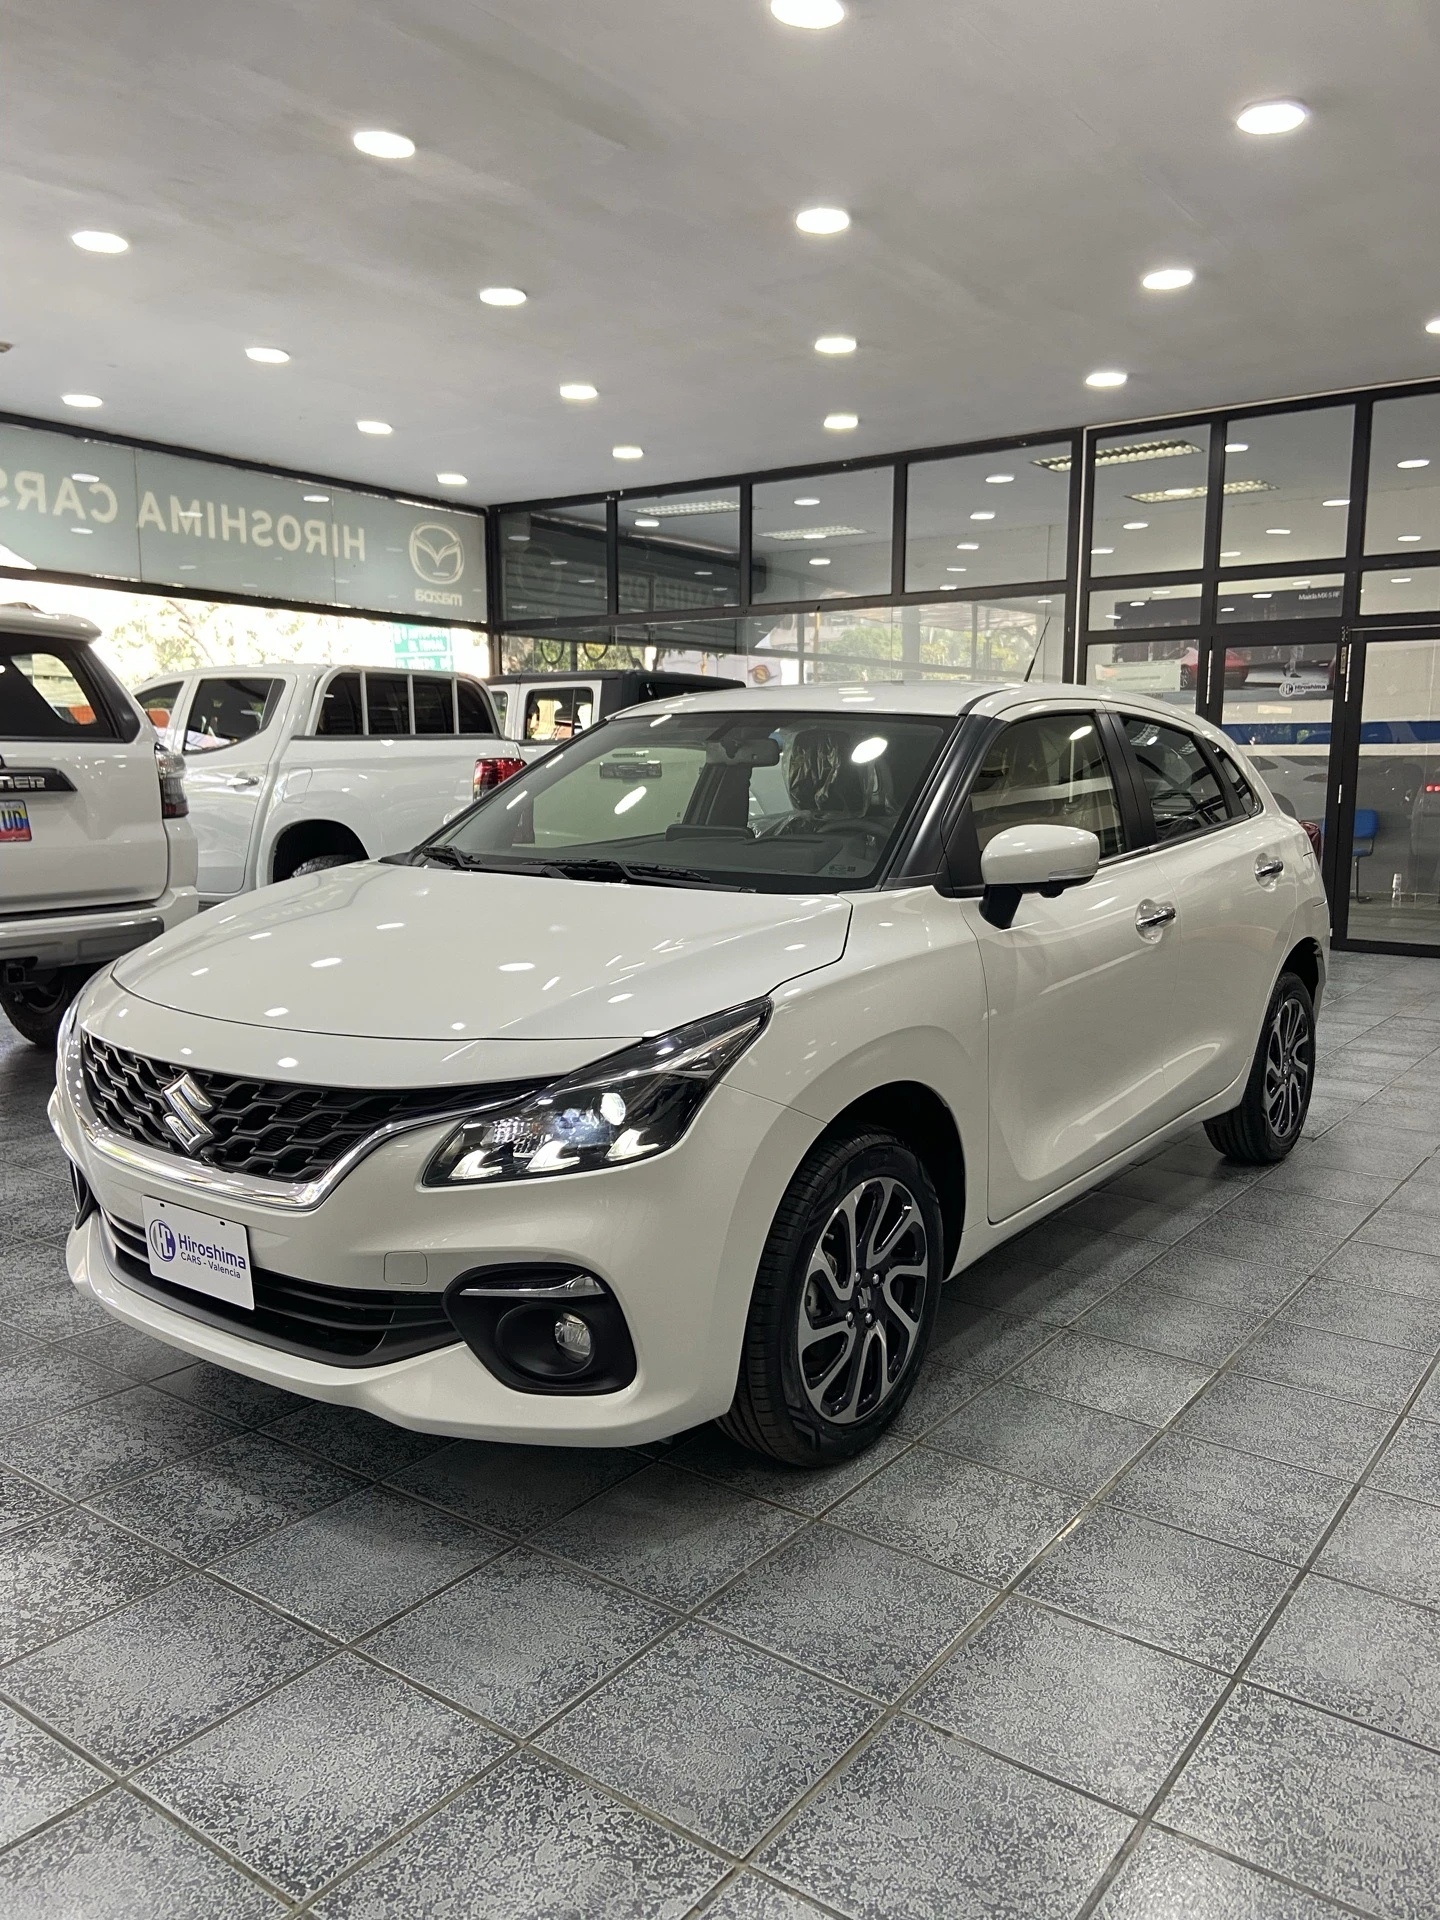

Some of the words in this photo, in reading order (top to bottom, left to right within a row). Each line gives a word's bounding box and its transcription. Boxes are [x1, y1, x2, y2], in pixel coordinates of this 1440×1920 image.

[178, 1233, 246, 1270] Hiroshima
[180, 1252, 202, 1265] CARS
[208, 1260, 241, 1279] Valencia
